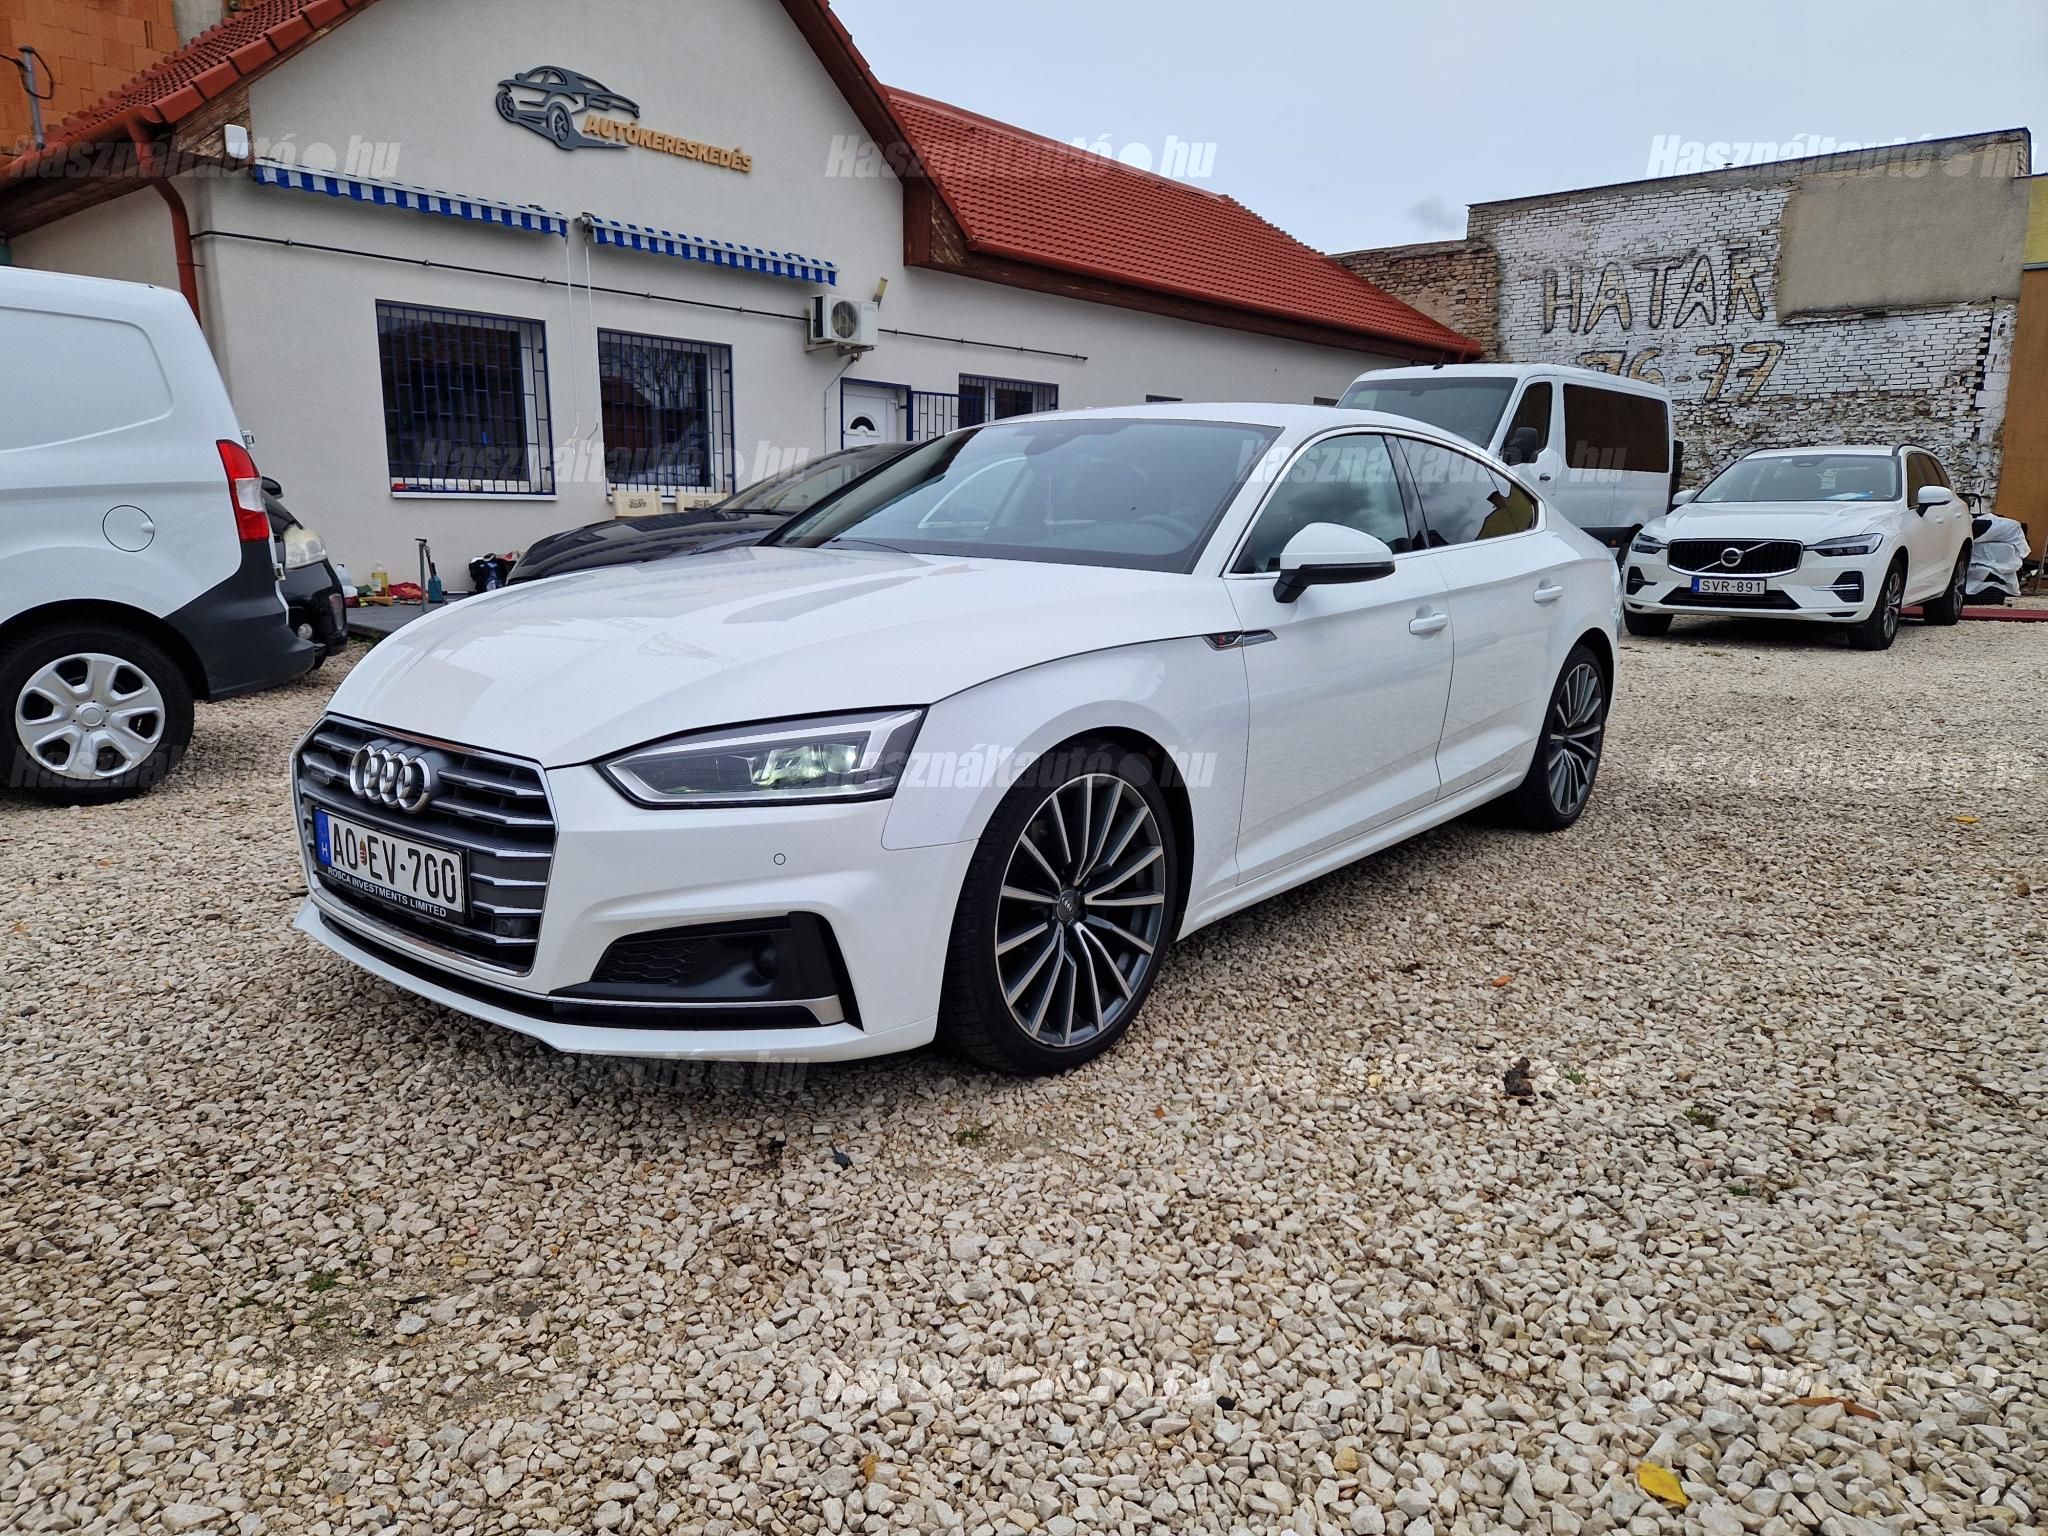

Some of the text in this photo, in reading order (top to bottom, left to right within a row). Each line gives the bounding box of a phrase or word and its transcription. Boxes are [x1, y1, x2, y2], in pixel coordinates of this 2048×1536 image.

[583, 114, 753, 174] AUTÓKERESKEDÉS
[1702, 580, 1761, 593] SVR-891
[321, 823, 457, 904] H AO EV-700
[327, 866, 447, 918] ROSCA INVESTMENTS LIMITED
